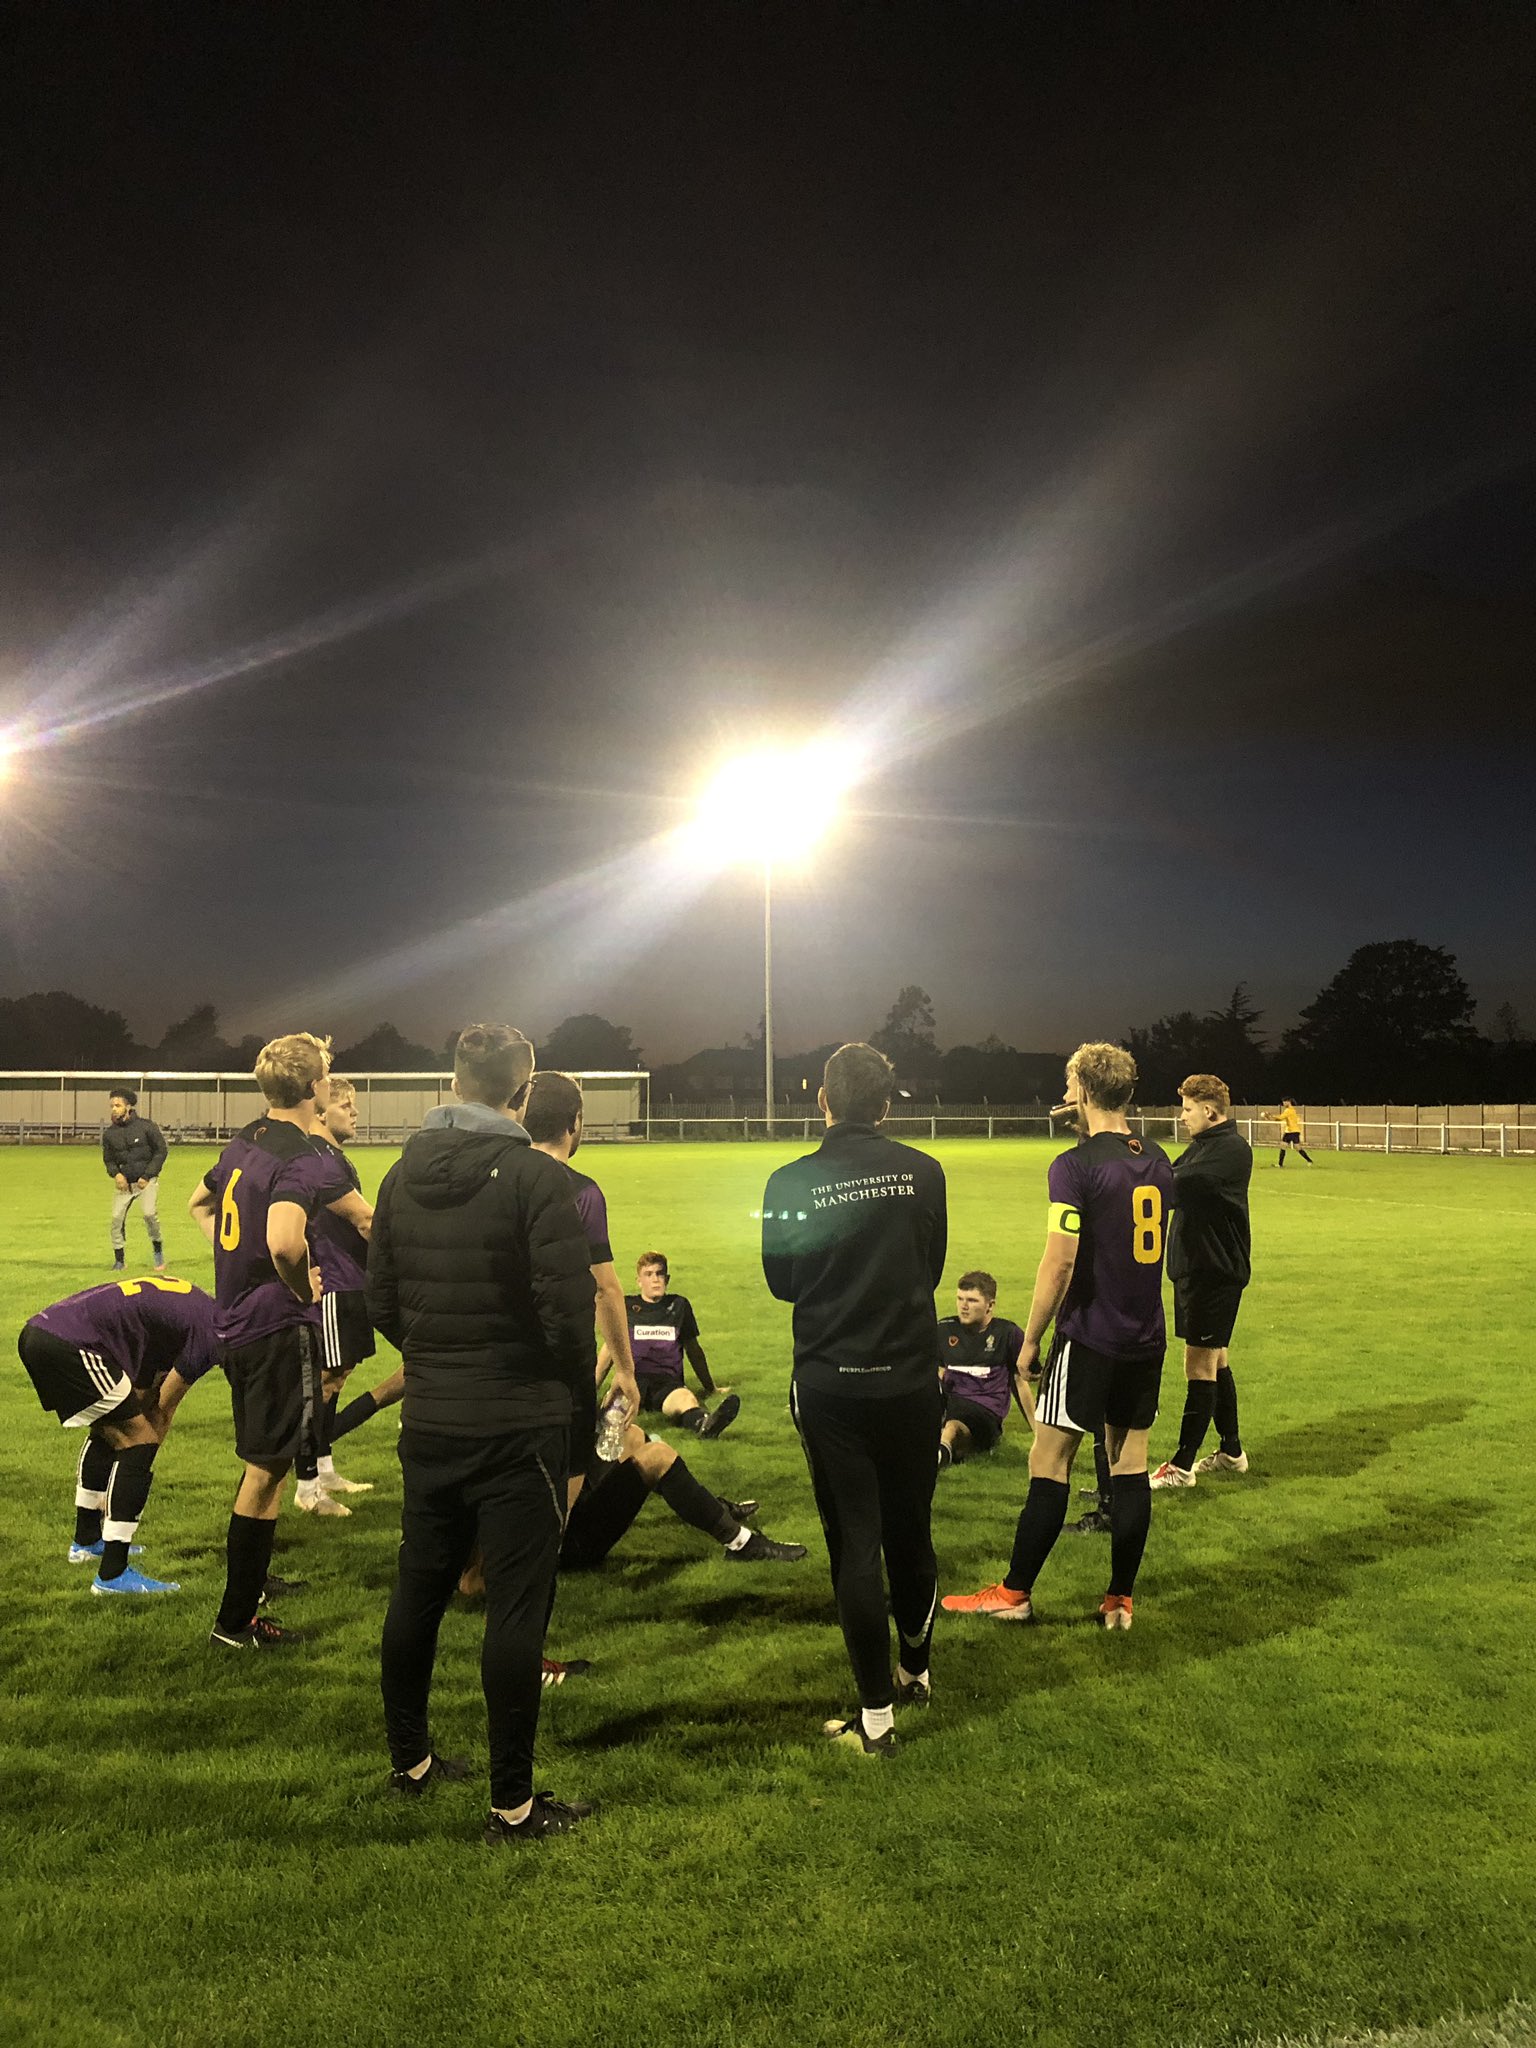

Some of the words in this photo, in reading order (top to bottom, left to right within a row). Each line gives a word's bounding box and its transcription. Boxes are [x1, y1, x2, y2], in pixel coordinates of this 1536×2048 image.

[220, 1168, 242, 1251] 6
[811, 1184, 833, 1196] THE
[835, 1173, 898, 1191] UNIVERSITY
[901, 1173, 914, 1181] OF
[813, 1185, 915, 1209] MANCHESTER
[1132, 1185, 1161, 1264] 8
